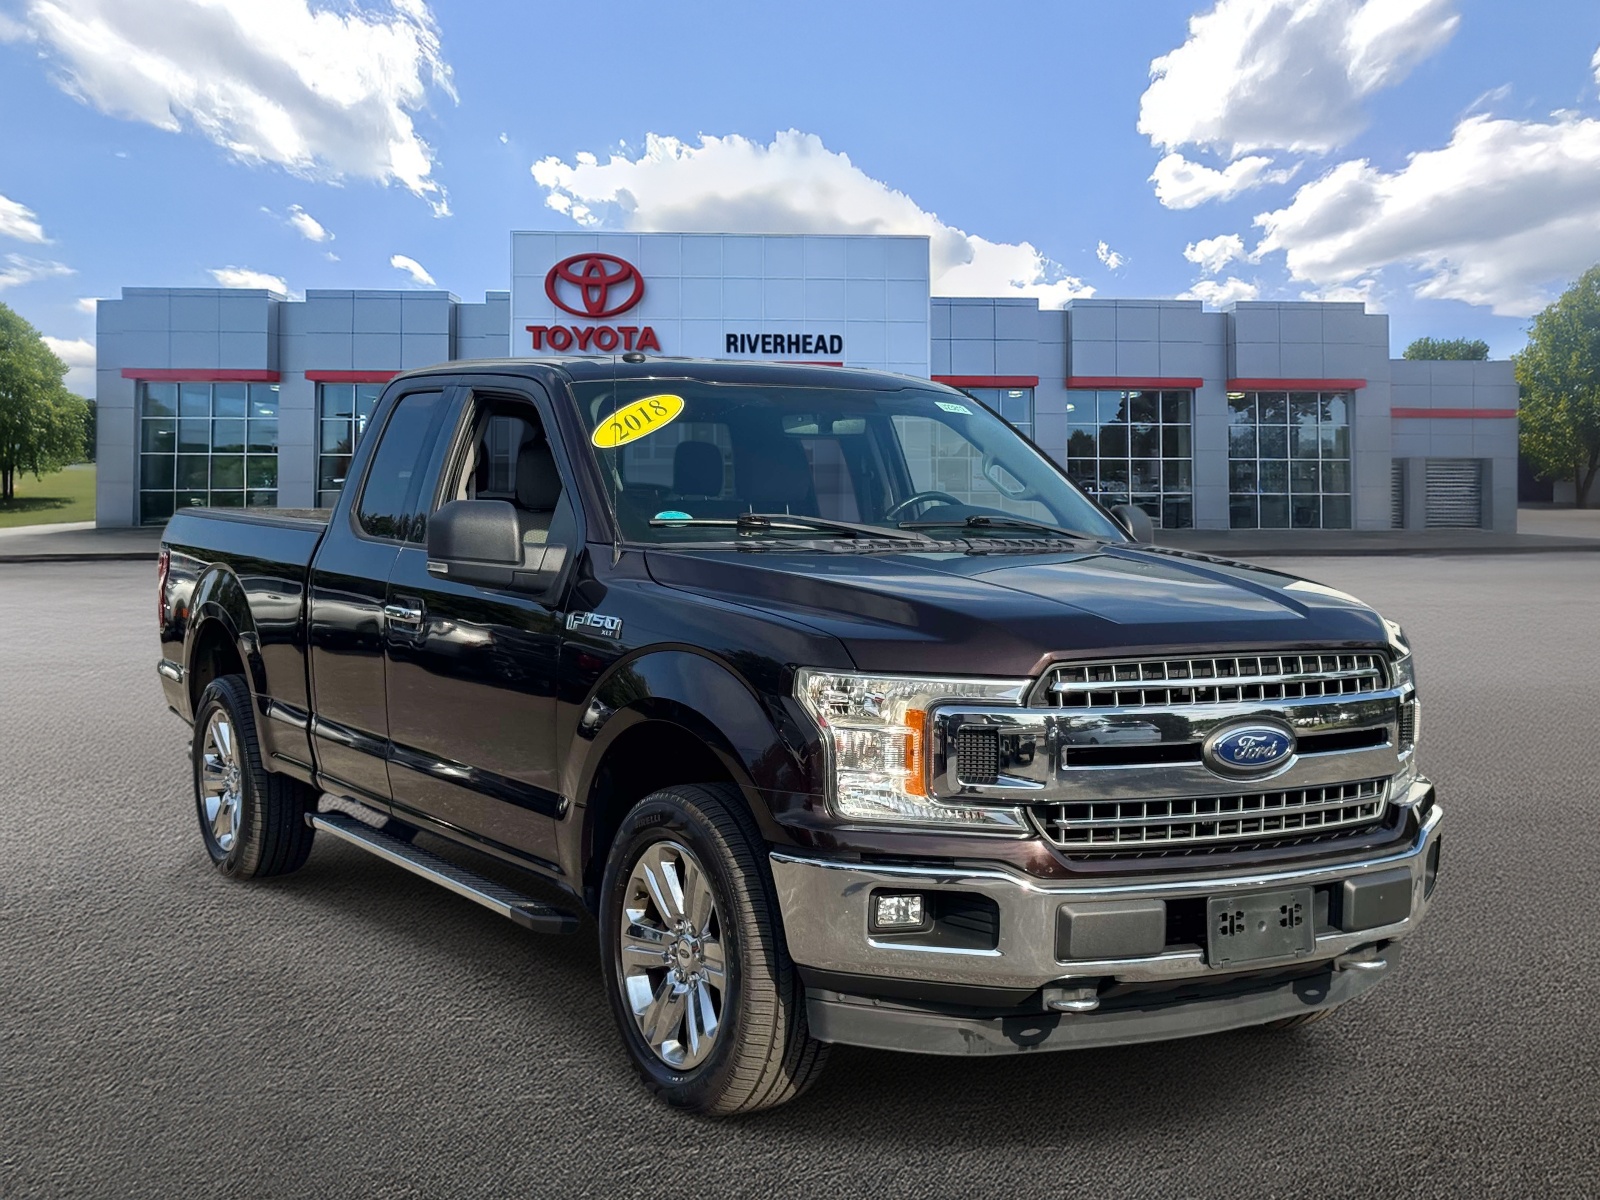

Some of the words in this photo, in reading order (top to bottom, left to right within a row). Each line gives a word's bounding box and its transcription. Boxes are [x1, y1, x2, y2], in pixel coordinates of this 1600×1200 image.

[526, 326, 660, 351] TOYOTA
[726, 333, 843, 354] RIVERHEAD
[610, 400, 667, 440] 2018
[1234, 736, 1278, 759] Ford
